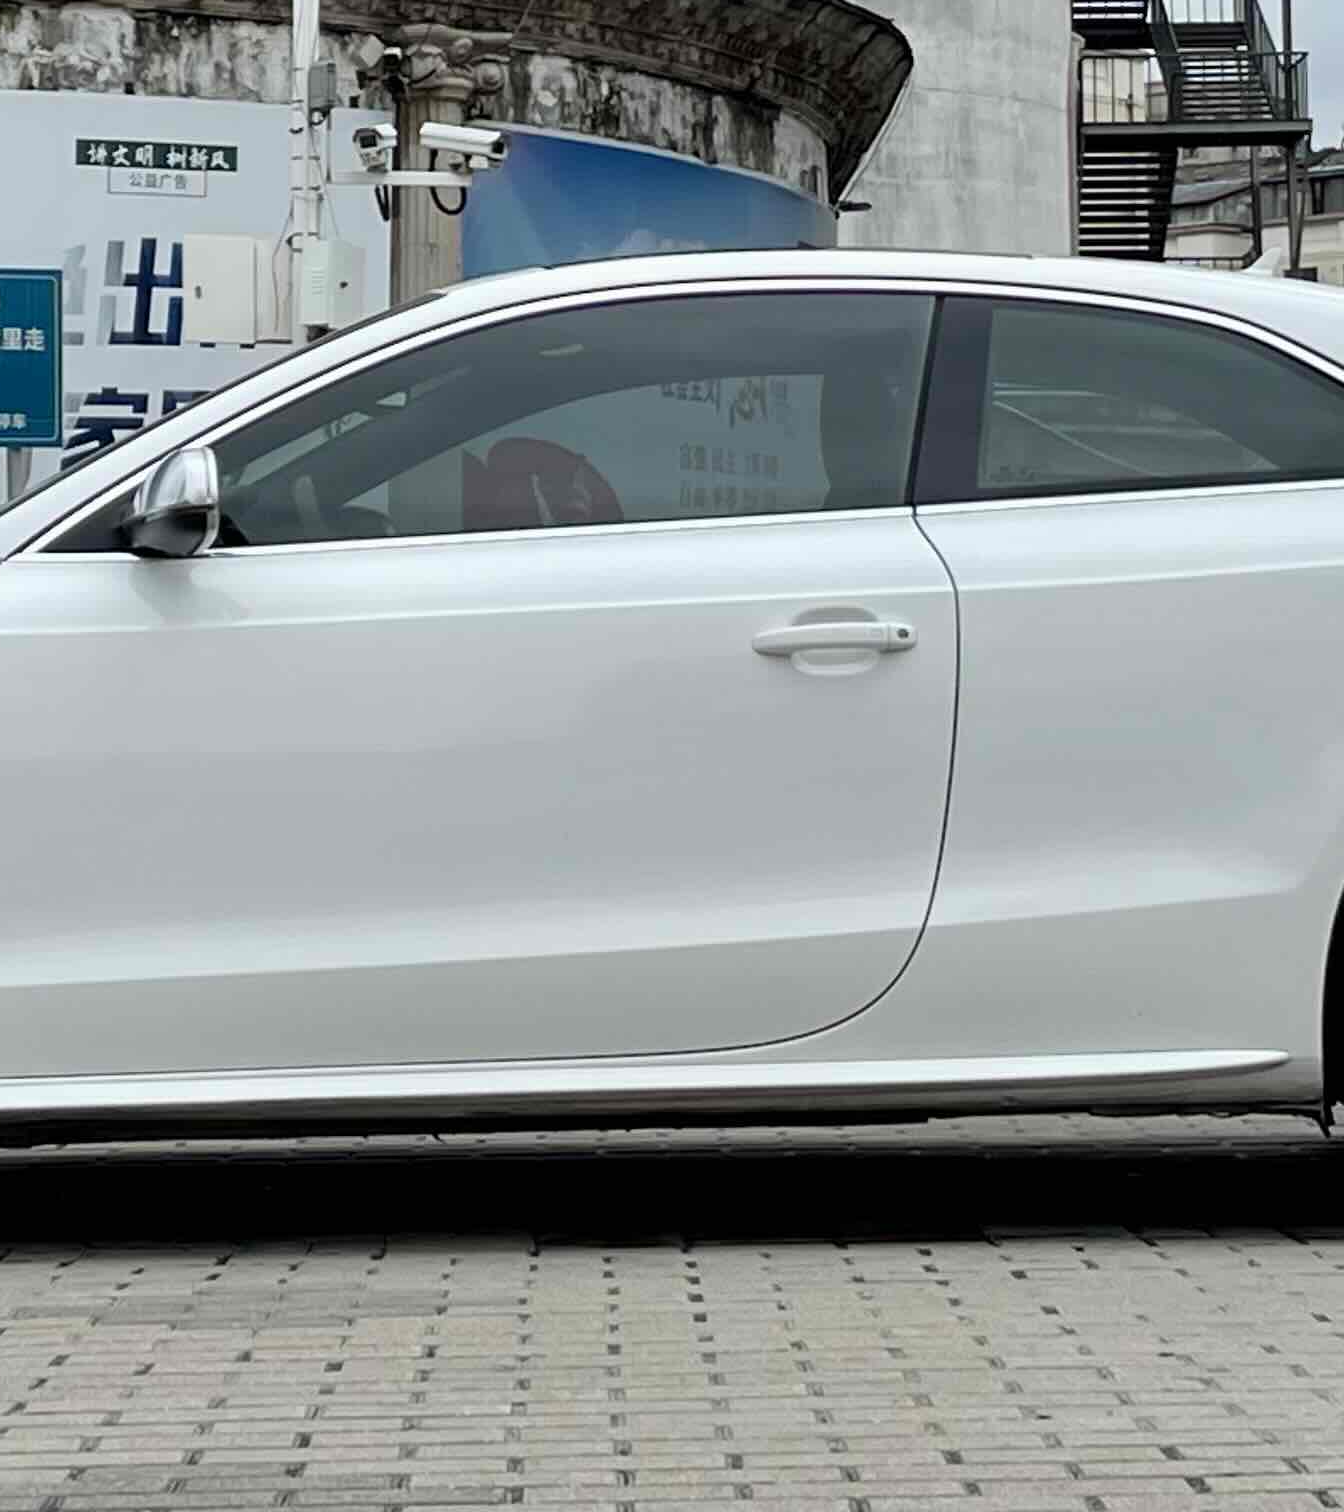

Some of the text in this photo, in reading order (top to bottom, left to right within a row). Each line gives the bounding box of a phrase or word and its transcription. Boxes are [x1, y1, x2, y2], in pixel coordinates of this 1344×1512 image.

[87, 143, 230, 169] 讲文明 树新风
[129, 173, 187, 189] 公益广告
